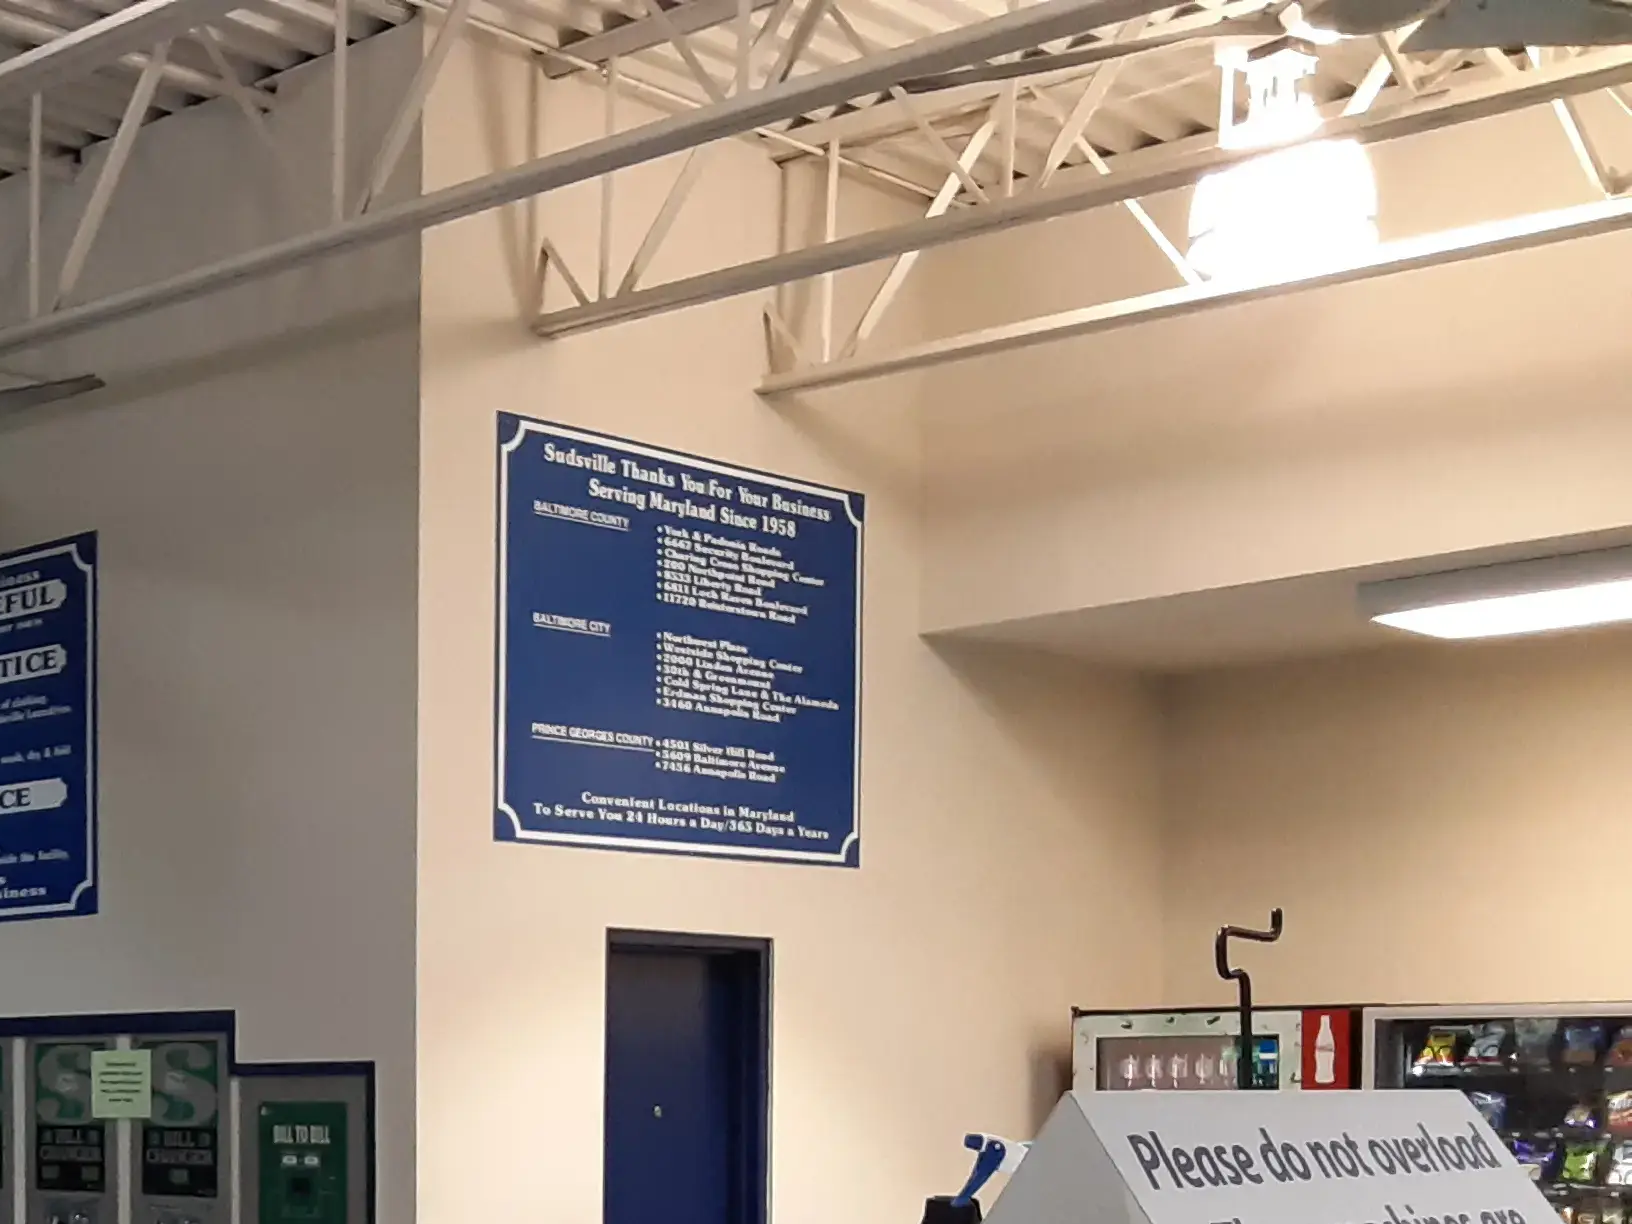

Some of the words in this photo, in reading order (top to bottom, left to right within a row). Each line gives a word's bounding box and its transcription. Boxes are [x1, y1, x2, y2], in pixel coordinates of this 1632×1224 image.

[544, 442, 616, 474] Sudsville
[621, 458, 675, 488] Thanks
[680, 473, 706, 494] You
[708, 478, 732, 501] For
[738, 485, 769, 509] Your
[771, 494, 832, 522] Business
[534, 500, 588, 520] BALTIMORE
[590, 511, 629, 527] COUNTY
[588, 478, 646, 510] Serving
[649, 491, 716, 522] Maryland
[720, 505, 757, 531] Since
[762, 515, 796, 539] 1958
[533, 612, 587, 630] BALTIMORE
[589, 621, 611, 632] CITY
[772, 690, 792, 703] The
[531, 722, 567, 736] PRINCE
[616, 732, 653, 747] COUNTY
[533, 802, 552, 816] To
[555, 804, 594, 820] Serve
[598, 809, 622, 821] You
[647, 812, 687, 827] Hours
[756, 822, 784, 837] Days
[581, 791, 654, 811] Convenient
[658, 799, 720, 816] Locations
[723, 805, 735, 817] in
[738, 805, 794, 823] Maryland
[273, 1125, 293, 1144] BILL
[295, 1125, 309, 1143] TO
[310, 1125, 330, 1144] BILL
[1127, 1130, 1265, 1191] Please
[1259, 1128, 1312, 1185] do
[1306, 1131, 1371, 1179] not
[1368, 1122, 1503, 1176] overload
